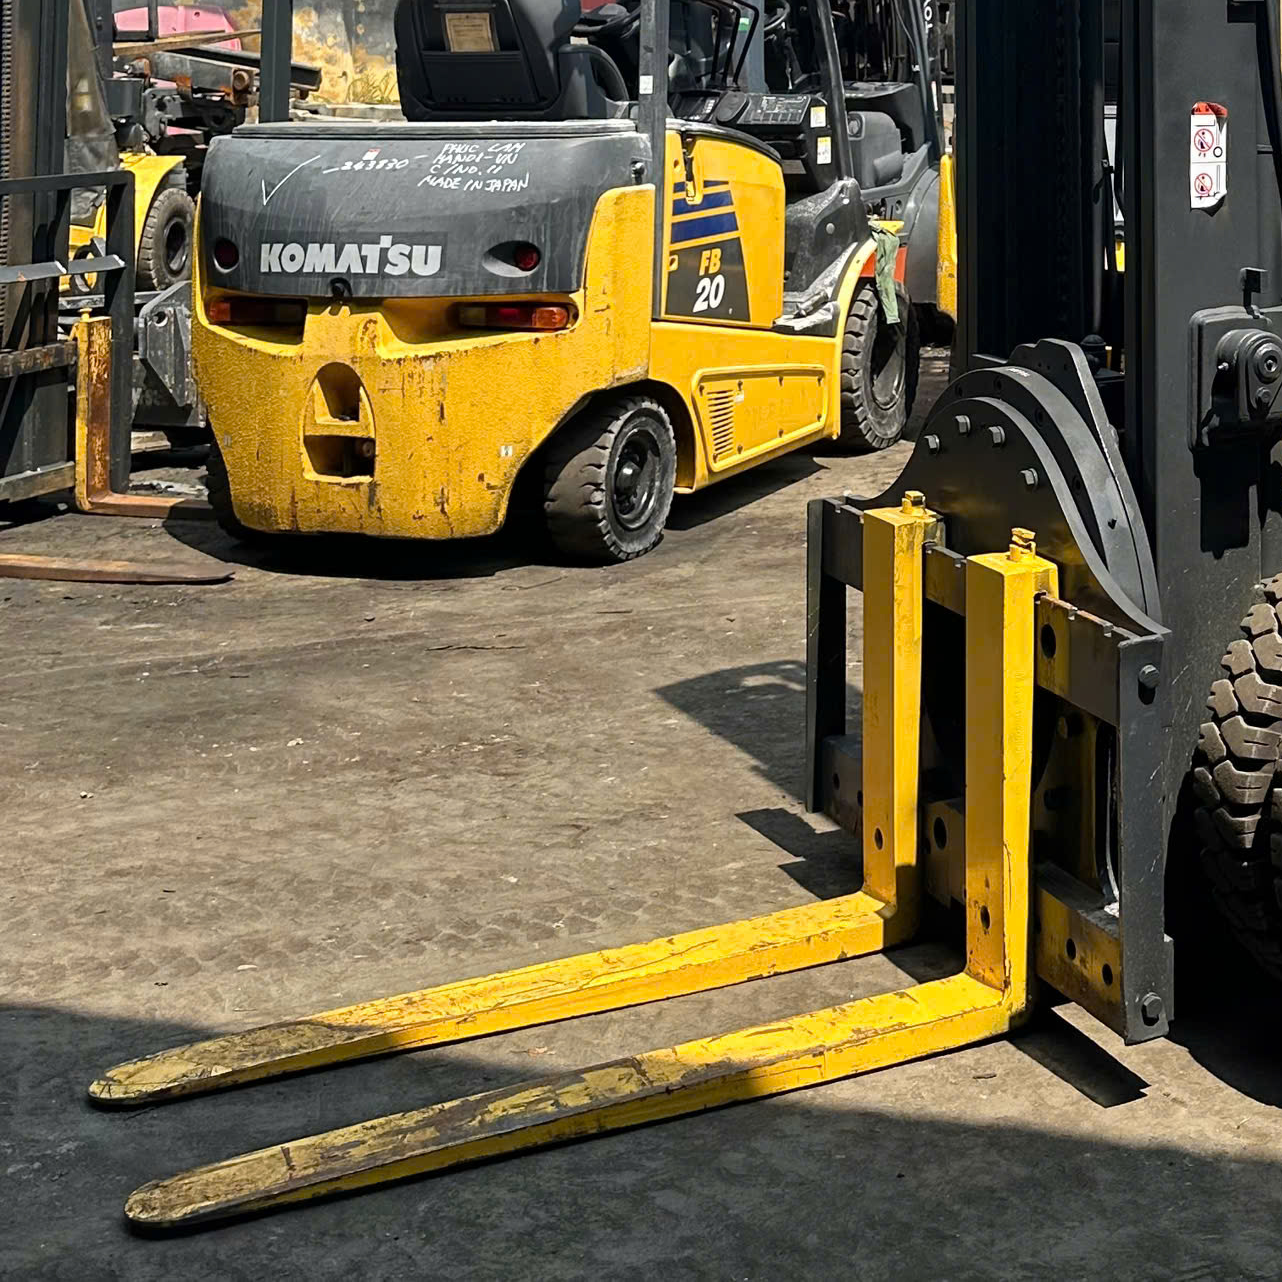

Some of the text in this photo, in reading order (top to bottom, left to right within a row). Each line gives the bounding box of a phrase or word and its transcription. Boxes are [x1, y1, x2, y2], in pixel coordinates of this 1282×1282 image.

[417, 172, 530, 192] MADE IN JAPAN
[260, 235, 442, 276] KOMATSU
[698, 248, 722, 276] FB
[693, 274, 725, 313] 20
